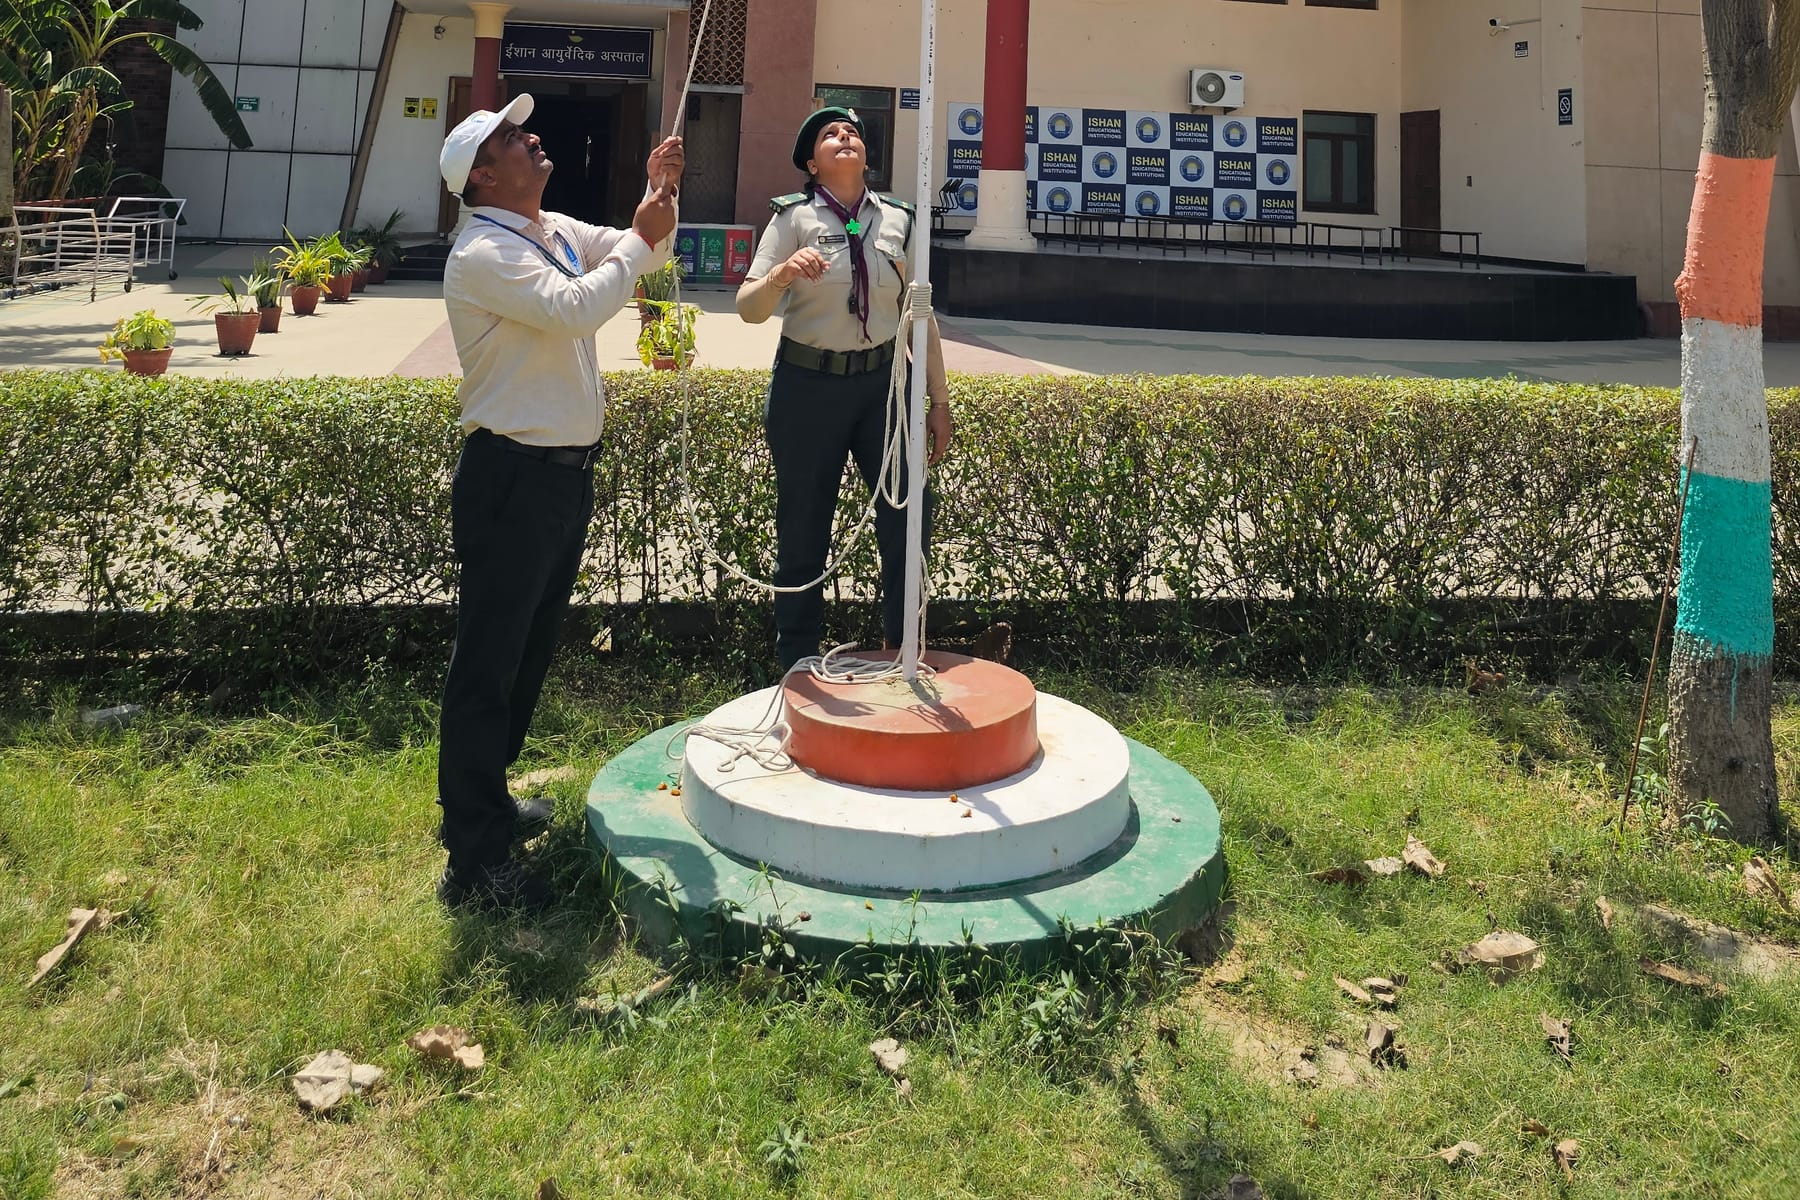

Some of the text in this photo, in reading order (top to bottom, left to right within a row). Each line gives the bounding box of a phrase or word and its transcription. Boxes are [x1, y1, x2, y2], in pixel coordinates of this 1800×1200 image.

[505, 43, 536, 60] ईशान
[600, 51, 645, 63] अस्पताल
[1088, 118, 1121, 127] ISHAN
[1176, 122, 1208, 131] ISHAN
[1262, 126, 1293, 135] ISHAN
[1043, 152, 1077, 162] ISHAN
[1132, 156, 1165, 166] ISHAN
[1219, 160, 1251, 169] ISHAN
[1087, 192, 1120, 201] ISHAN
[1175, 196, 1208, 205] ISHAN
[1262, 199, 1294, 208] ISHAN
